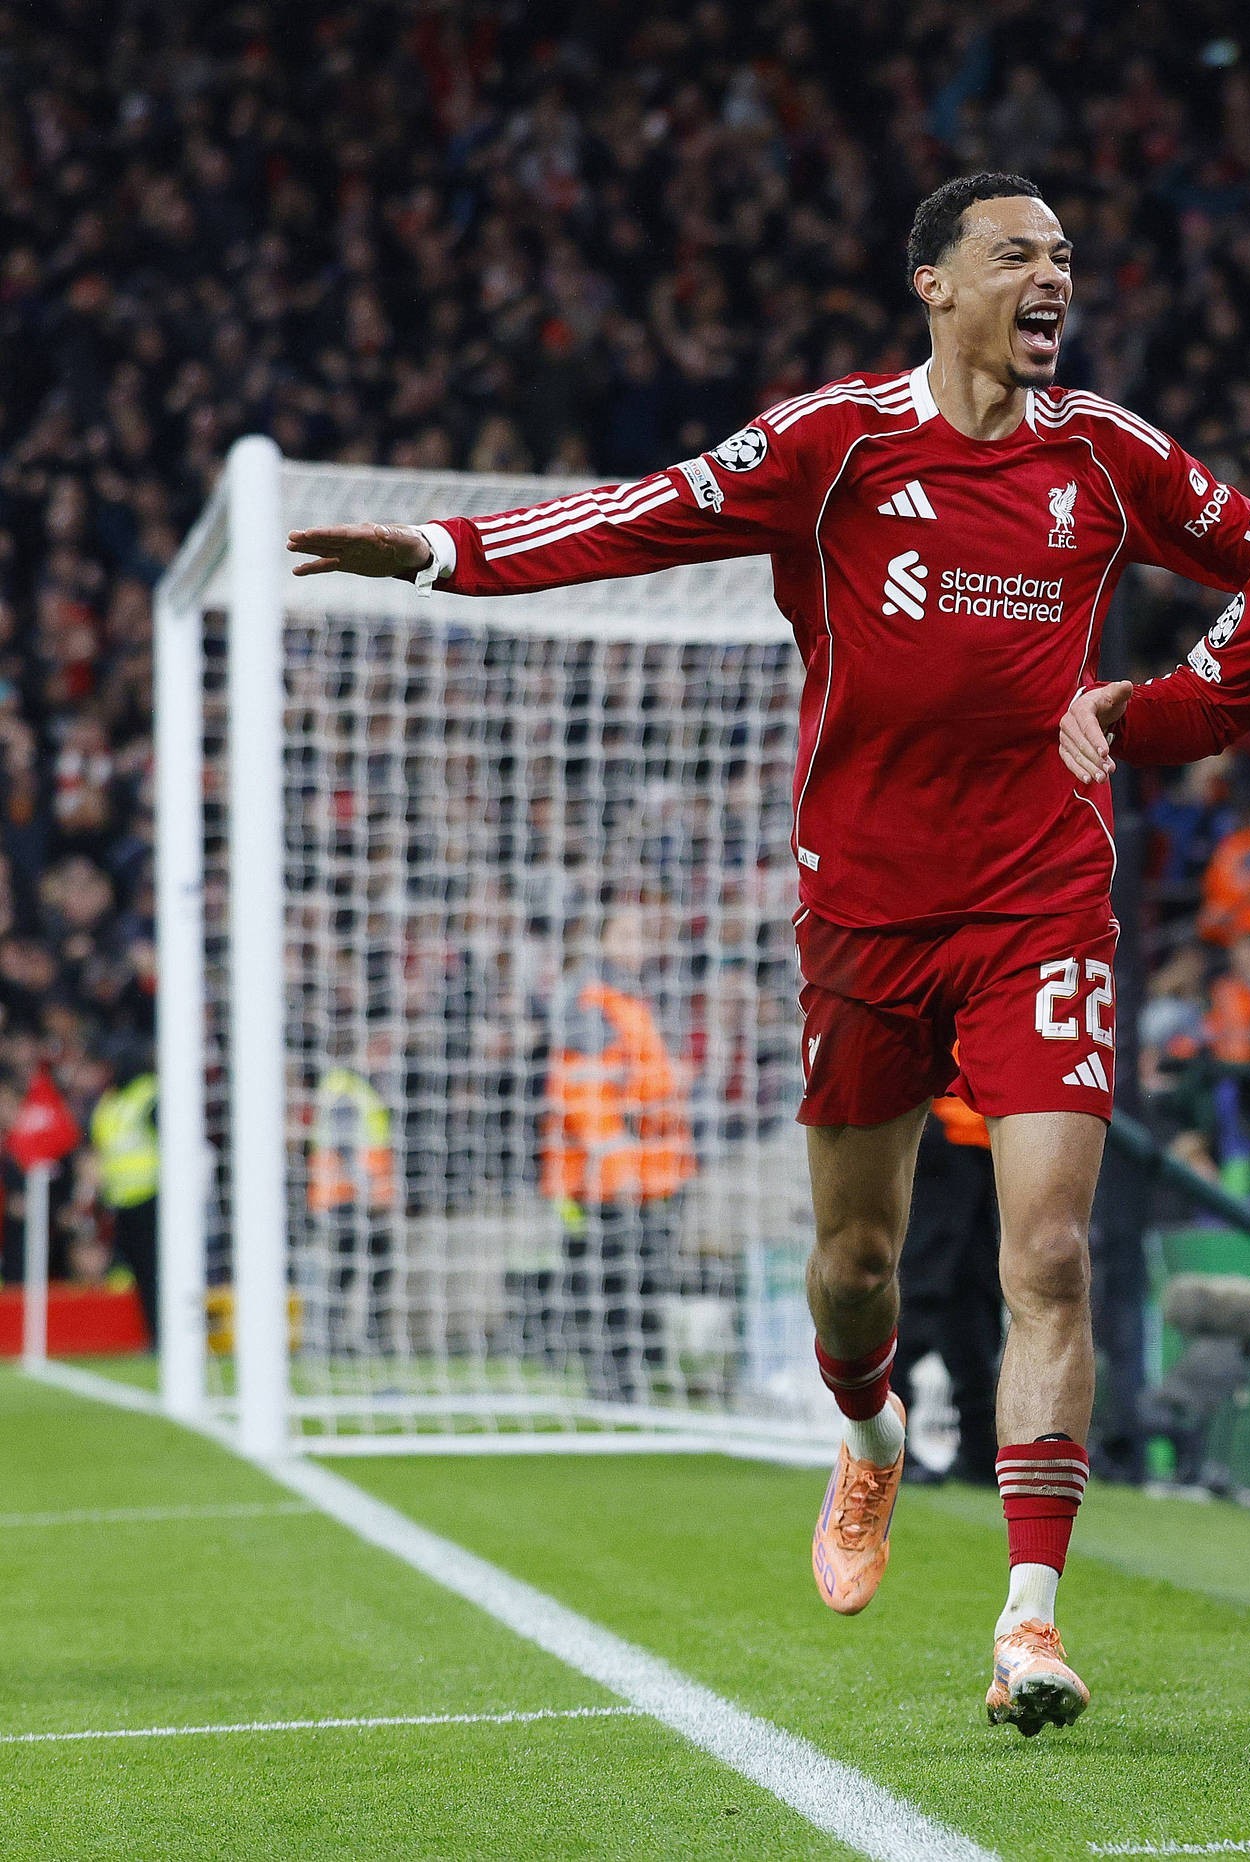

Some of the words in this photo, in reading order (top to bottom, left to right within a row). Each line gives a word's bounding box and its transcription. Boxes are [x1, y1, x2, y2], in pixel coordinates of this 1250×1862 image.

[1048, 533, 1077, 549] L.F.C.
[941, 567, 1063, 600] standard
[939, 591, 1064, 623] chartered
[1035, 956, 1115, 1050] 22
